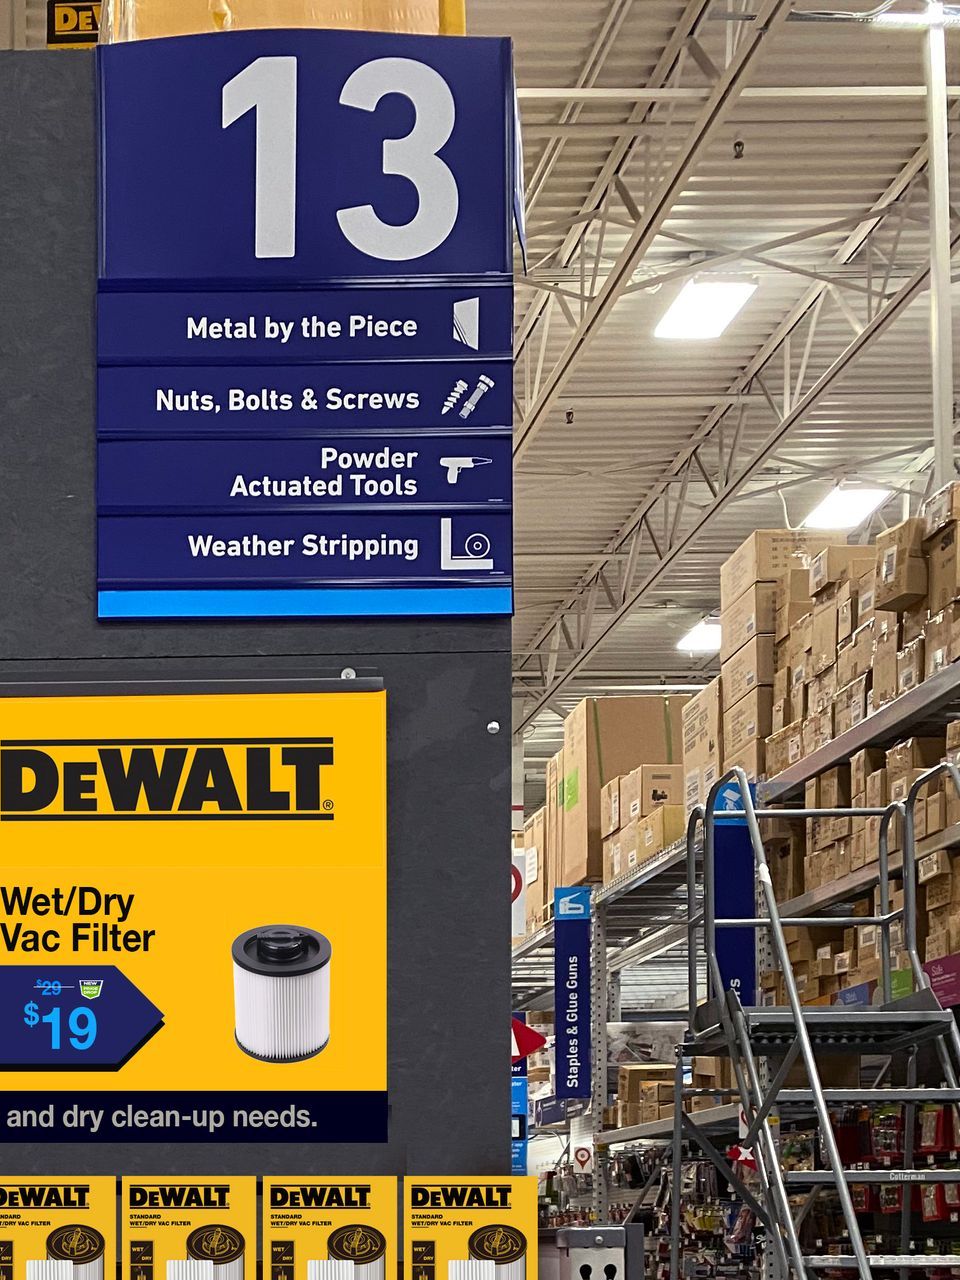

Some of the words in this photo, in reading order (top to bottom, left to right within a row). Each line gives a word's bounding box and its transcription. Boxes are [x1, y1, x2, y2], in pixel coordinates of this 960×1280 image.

[222, 50, 459, 260] 13
[188, 317, 256, 338] Metal
[265, 317, 294, 343] by
[301, 316, 341, 337] the
[350, 315, 417, 337] Piece
[157, 389, 220, 414] Nuts,
[229, 389, 292, 410] Bolts
[301, 389, 318, 410] &
[326, 388, 419, 409] Screws
[322, 447, 418, 468] Powder
[230, 475, 342, 497] Actuated
[350, 474, 418, 496] Tools
[188, 535, 295, 556] Weather
[302, 534, 418, 560] Stripping
[0, 886, 135, 923] Wet/Dry
[0, 923, 61, 952] Vac
[72, 921, 156, 953] Filter
[567, 955, 578, 988] Guns
[36, 979, 62, 996] $29
[567, 993, 578, 1021] Glue
[23, 1000, 97, 1051] $19
[566, 1026, 578, 1035] &
[567, 1039, 581, 1088] Staples
[7, 1105, 53, 1128] and
[63, 1105, 104, 1133] dry
[112, 1105, 224, 1133] clean-up
[234, 1105, 317, 1128] needs.
[889, 1172, 926, 1181] Cotterman
